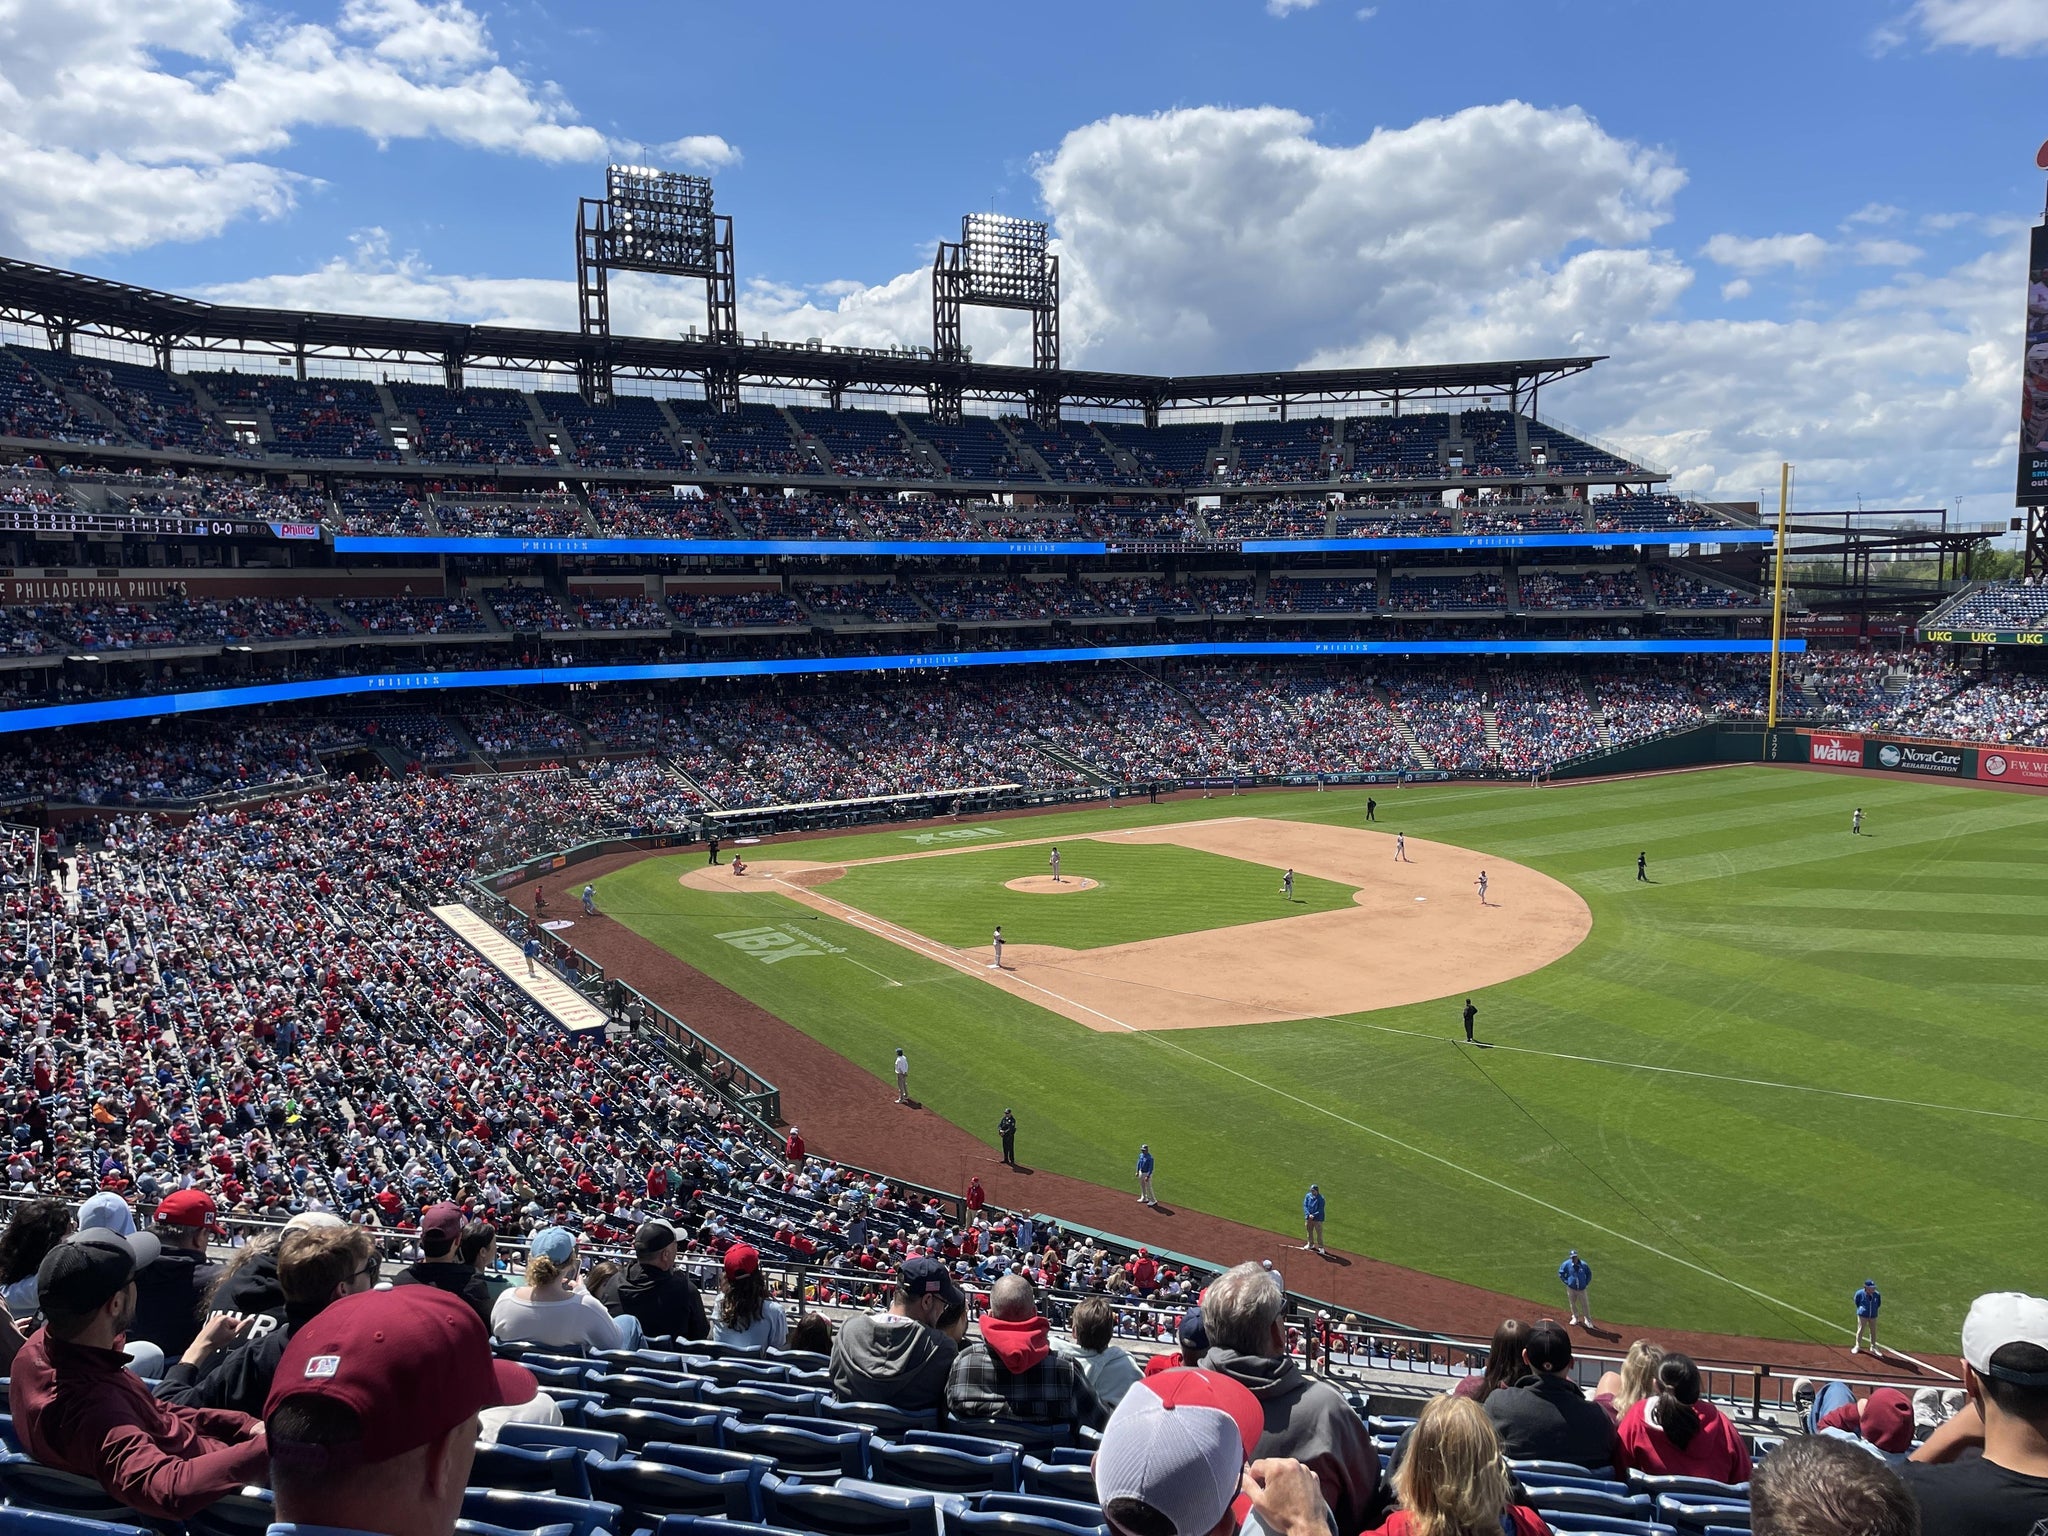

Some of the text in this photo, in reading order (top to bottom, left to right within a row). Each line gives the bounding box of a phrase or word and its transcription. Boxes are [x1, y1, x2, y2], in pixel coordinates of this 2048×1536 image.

[14, 512, 19, 520] 0
[118, 520, 171, 531] R H E
[212, 522, 232, 534] 0-0
[282, 524, 315, 536] Phillies
[16, 582, 121, 598] PHILADELPHIA
[130, 582, 187, 596] PHILLS
[1928, 631, 1952, 642] UKG
[1971, 632, 1997, 643] UKG
[2016, 633, 2043, 644] UKG
[1814, 744, 1860, 763] Wawa
[1902, 748, 1960, 764] NovaCare
[1902, 762, 1957, 772] REHABILITATION
[713, 926, 826, 964] IBX
